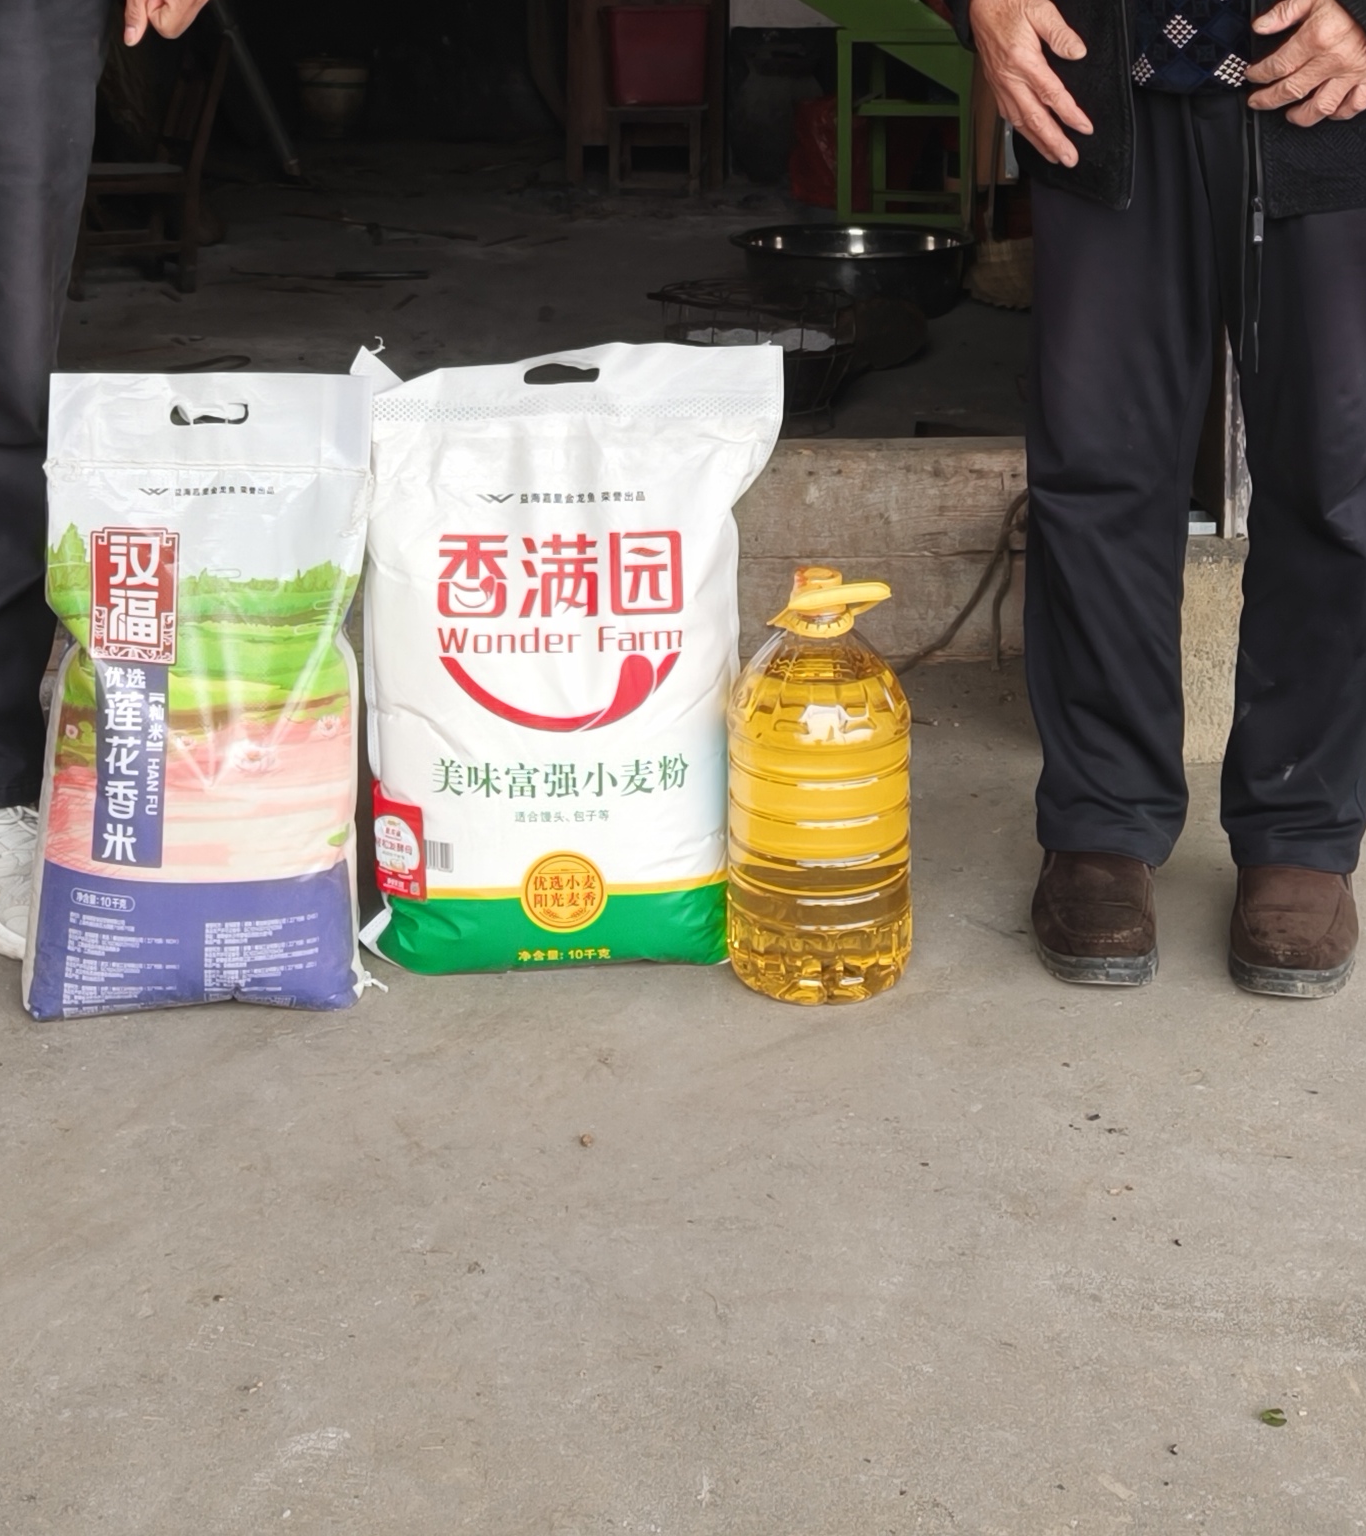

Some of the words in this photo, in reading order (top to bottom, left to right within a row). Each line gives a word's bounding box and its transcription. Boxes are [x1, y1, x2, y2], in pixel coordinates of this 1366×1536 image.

[109, 534, 161, 645] 汉福
[437, 530, 684, 619] 香满园
[437, 626, 582, 654] Wonder
[597, 625, 683, 653] Farm
[104, 666, 147, 690] 优选
[101, 691, 145, 863] 莲花香米
[146, 758, 161, 793] HAN
[432, 753, 690, 800] 美味富强小麦粉
[145, 795, 159, 816] FU
[533, 874, 597, 892] 优选小麦
[533, 891, 597, 908] 阳光麦香
